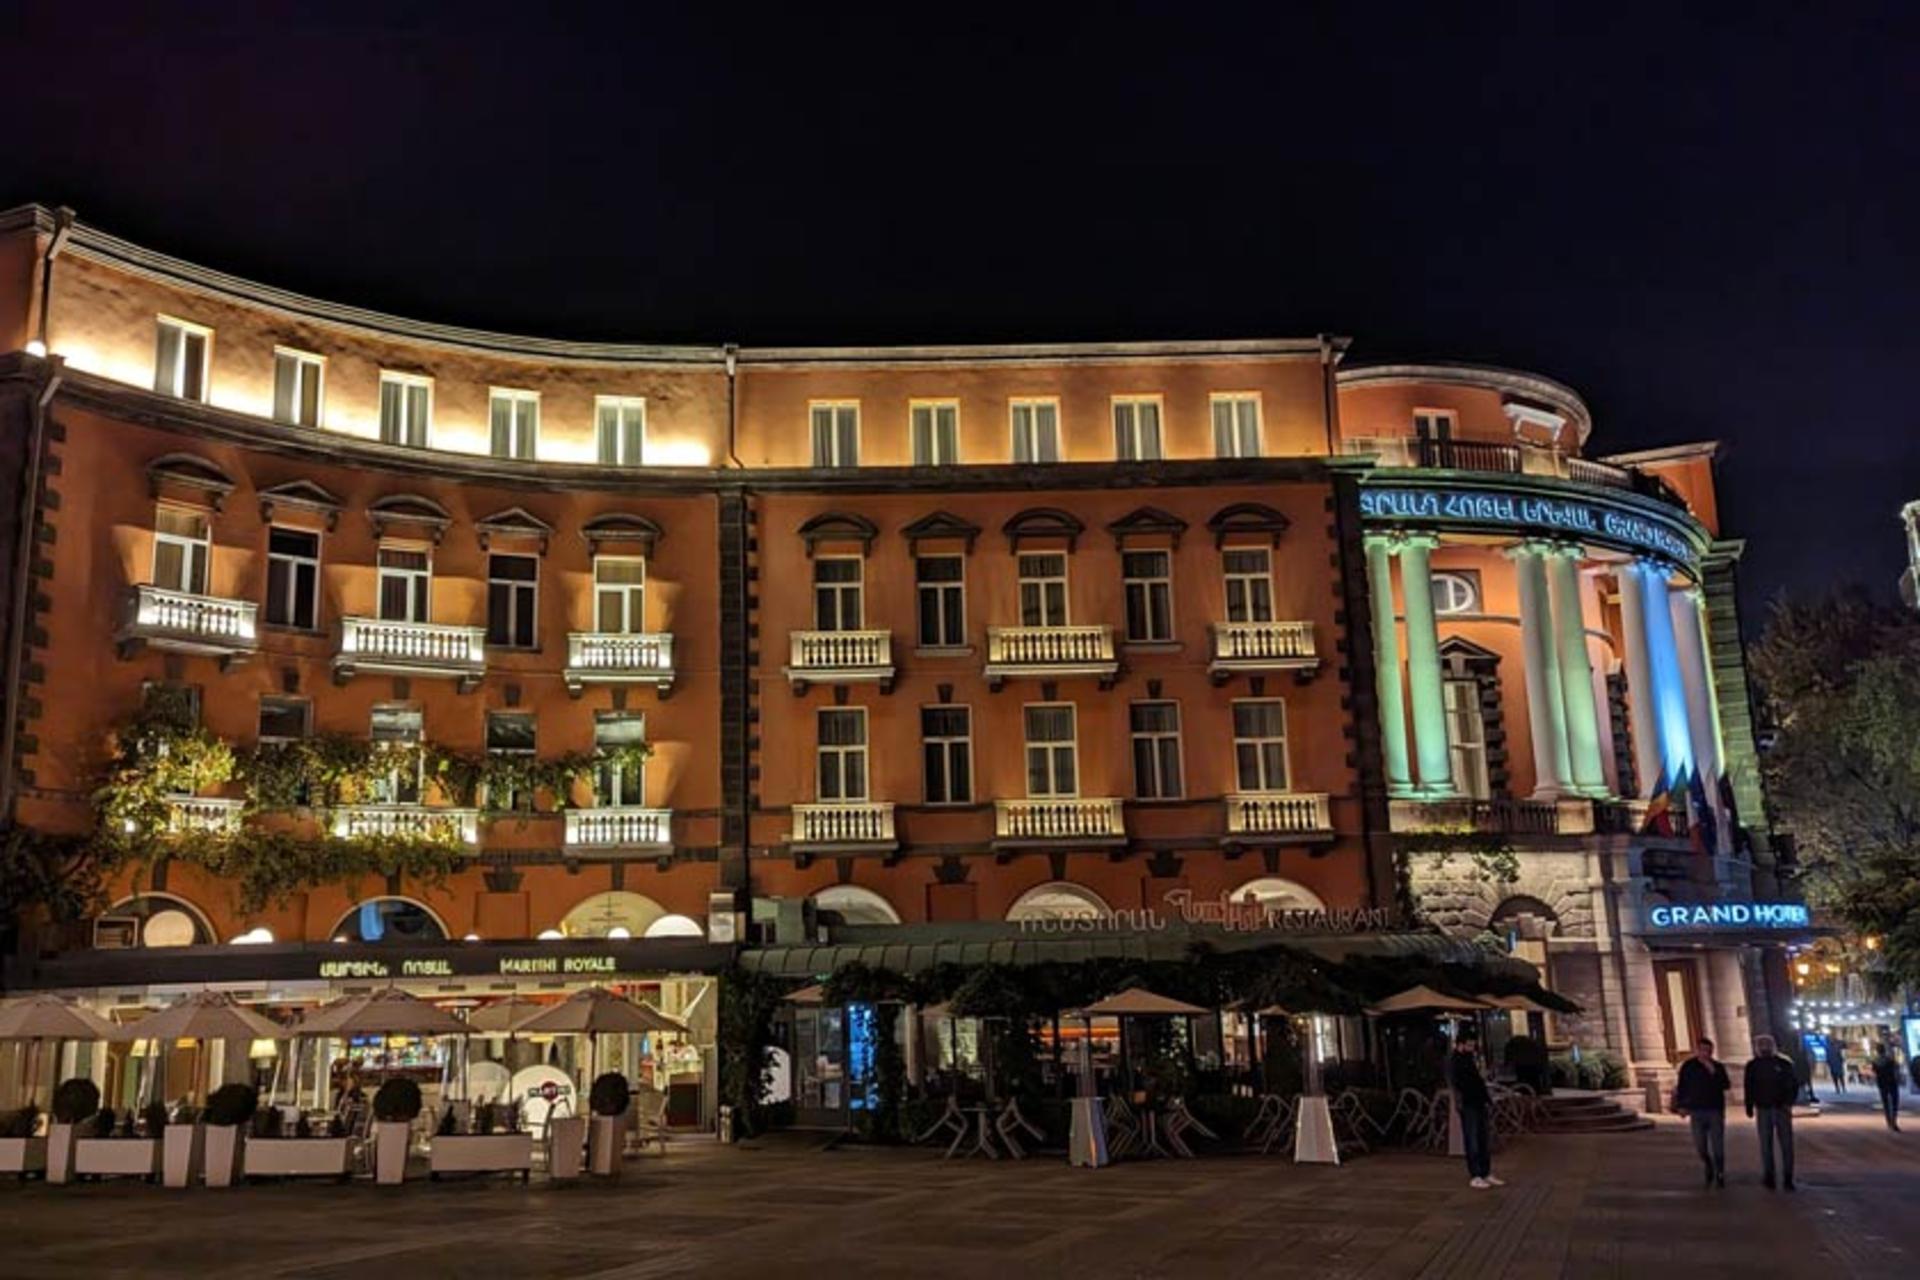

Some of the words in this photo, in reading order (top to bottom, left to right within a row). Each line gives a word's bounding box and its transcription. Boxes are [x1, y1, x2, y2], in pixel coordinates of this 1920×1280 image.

[1269, 906, 1390, 932] RESTAURANT
[1652, 903, 1750, 926] GRAND
[1753, 903, 1808, 923] HOTEL
[499, 957, 557, 975] MARTINI
[563, 956, 616, 973] ROYALE
